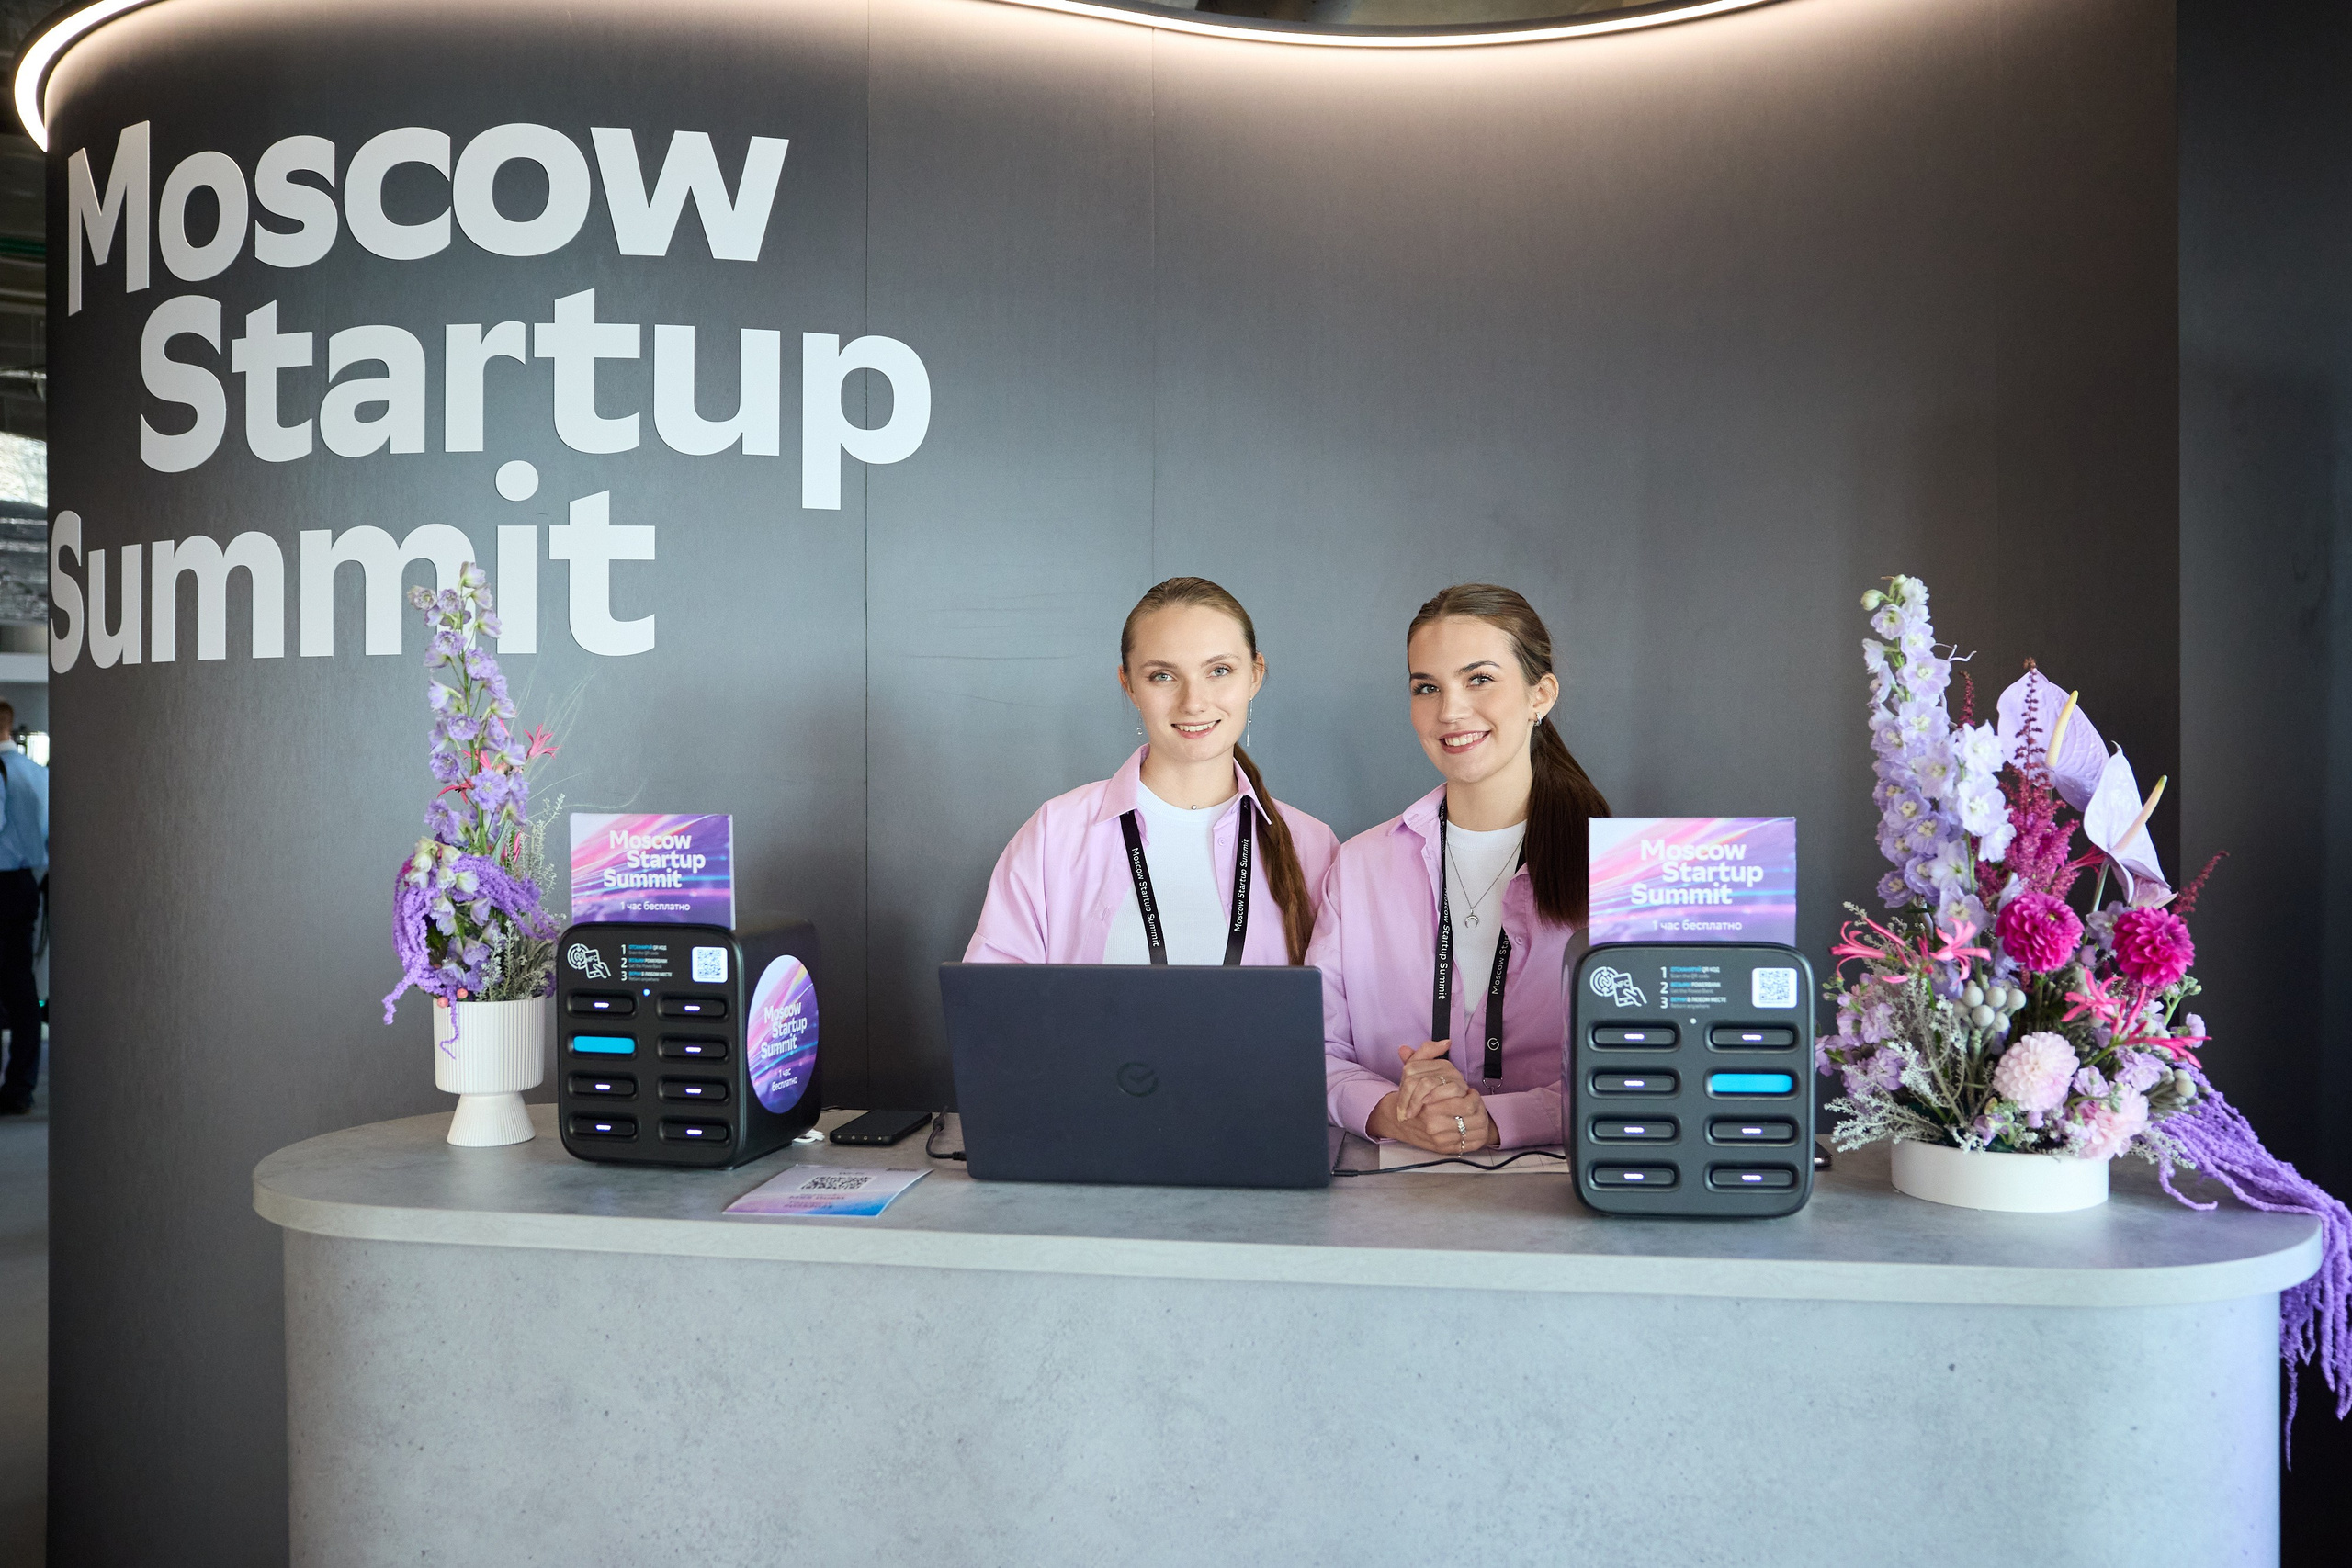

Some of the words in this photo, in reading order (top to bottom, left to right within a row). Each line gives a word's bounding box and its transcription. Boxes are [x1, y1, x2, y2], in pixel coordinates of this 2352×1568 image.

[68, 119, 790, 317] Moscow
[140, 288, 933, 511] Startup
[49, 459, 656, 674] Summit
[609, 829, 692, 850] Moscow
[1640, 839, 1747, 861] Moscow
[626, 849, 706, 874] Startup
[1239, 839, 1250, 867] Summit
[603, 867, 683, 888] Summit
[1237, 869, 1249, 899] Startup
[1661, 861, 1764, 887] Startup
[1131, 847, 1145, 880] Moscow
[1138, 881, 1152, 912] Startup
[1147, 913, 1160, 947] Summit
[1630, 882, 1733, 905] Summit
[620, 901, 625, 911] 1
[627, 902, 642, 911] час
[643, 900, 691, 911] бесплатно
[1234, 899, 1245, 932] Moscow
[1652, 919, 1657, 931] 1
[1660, 921, 1680, 931] час
[1681, 919, 1743, 931] бесплатно
[620, 944, 627, 955] 1
[1438, 924, 1451, 960] Startup
[620, 957, 628, 968] 2
[1491, 958, 1505, 995] Moscow
[1498, 934, 1509, 955] Star
[1660, 966, 1667, 979] 1
[620, 970, 628, 982] 3
[1438, 960, 1448, 1000] Summit
[1659, 981, 1668, 994] 2
[763, 1002, 802, 1024] Moscow
[1659, 996, 1668, 1009] 3
[772, 1017, 808, 1038] Startup
[760, 1033, 797, 1059] Summit
[778, 1068, 783, 1078] 1
[782, 1067, 792, 1077] час
[772, 1076, 798, 1092] бесплатно
